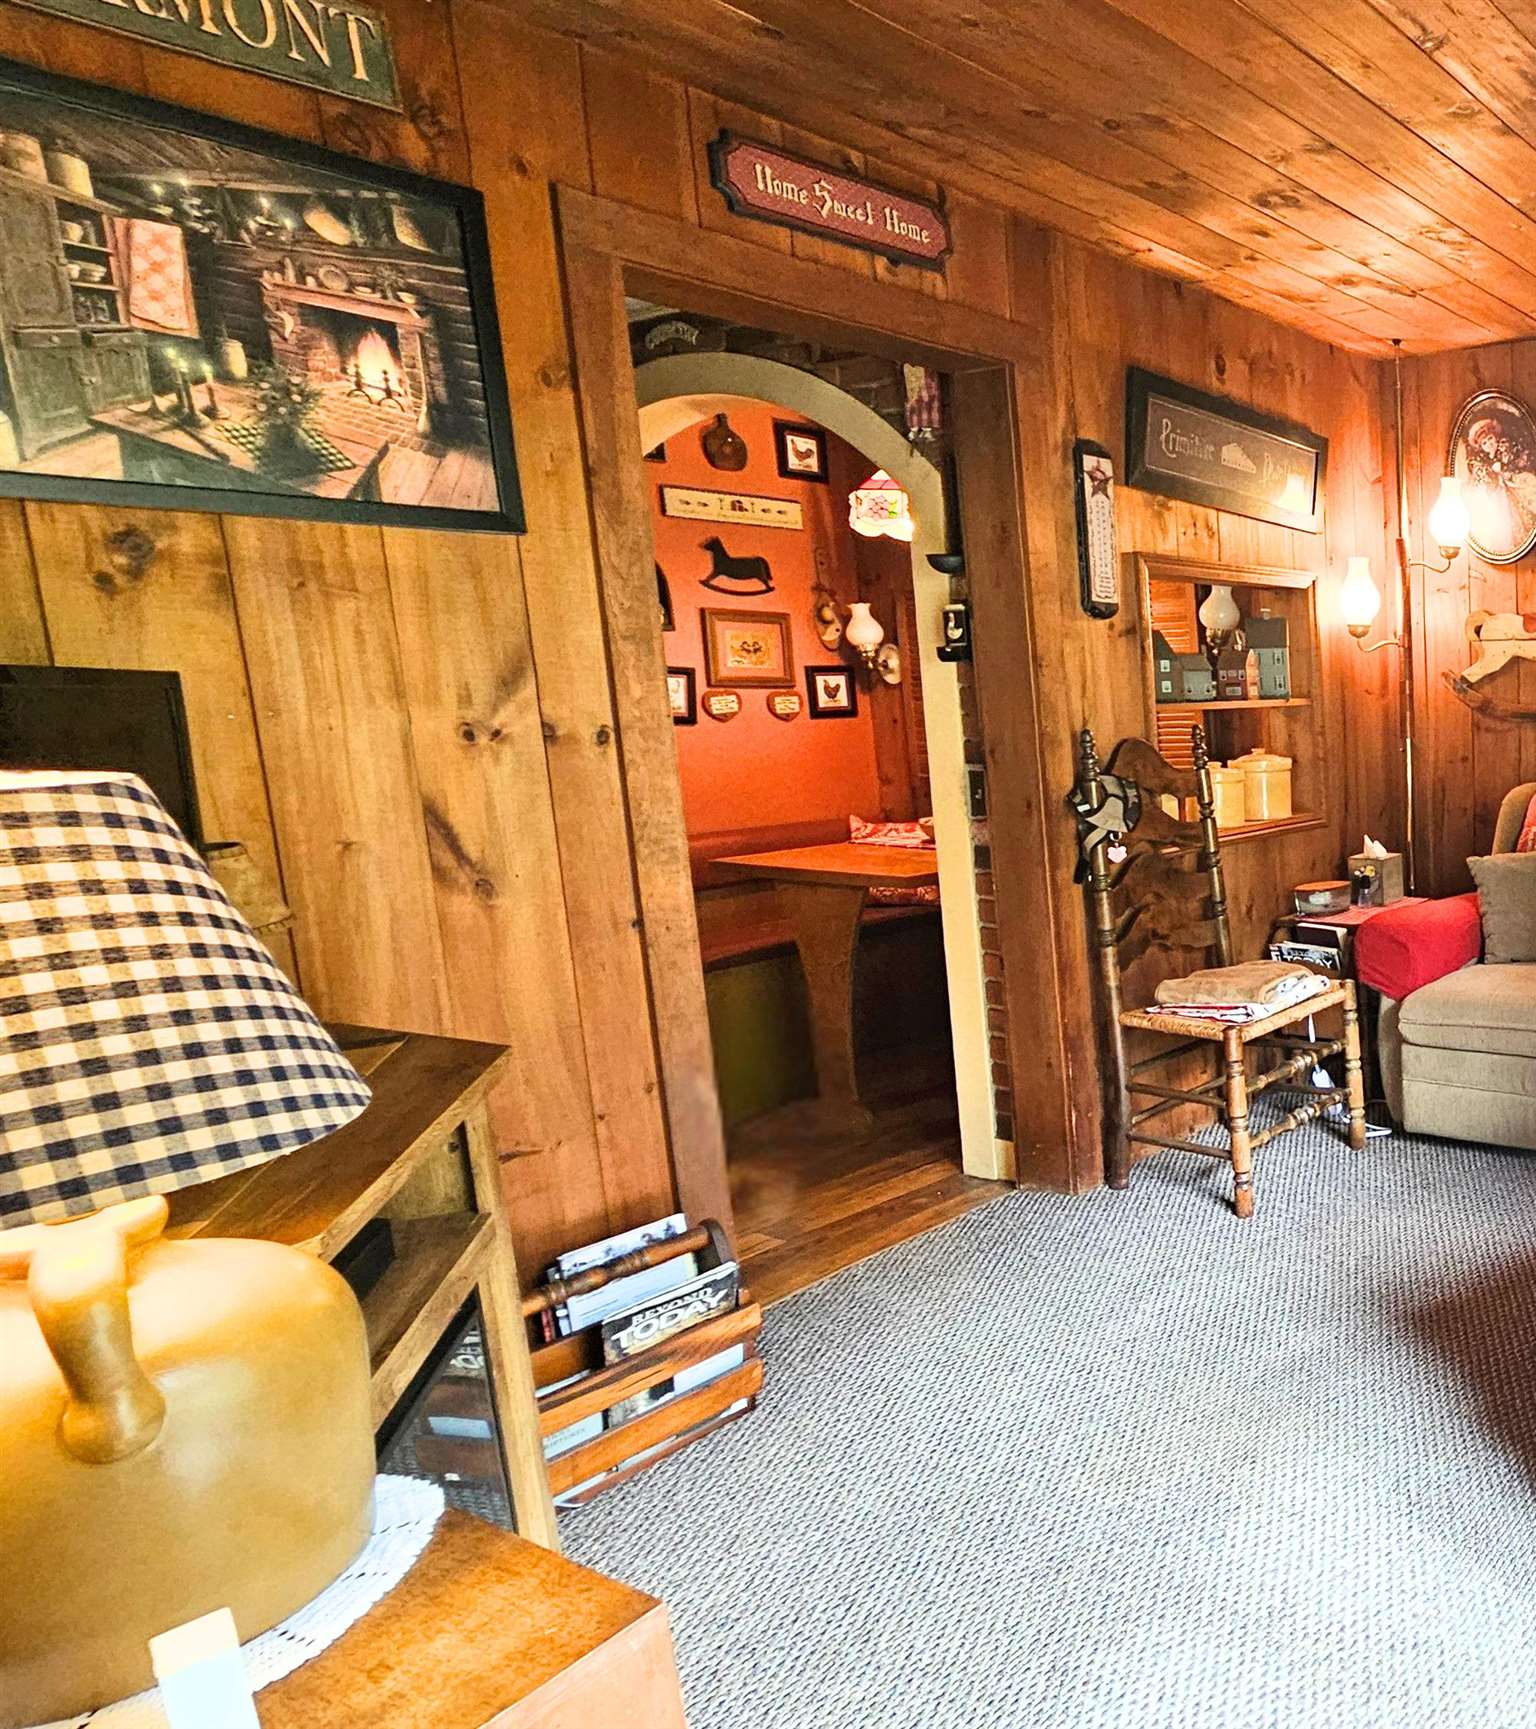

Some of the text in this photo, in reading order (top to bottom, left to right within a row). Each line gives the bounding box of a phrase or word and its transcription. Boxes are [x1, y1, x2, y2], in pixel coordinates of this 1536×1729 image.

[103, 0, 376, 81] ONT
[754, 161, 931, 243] Home Sweet Home
[610, 1288, 728, 1350] TODAY
